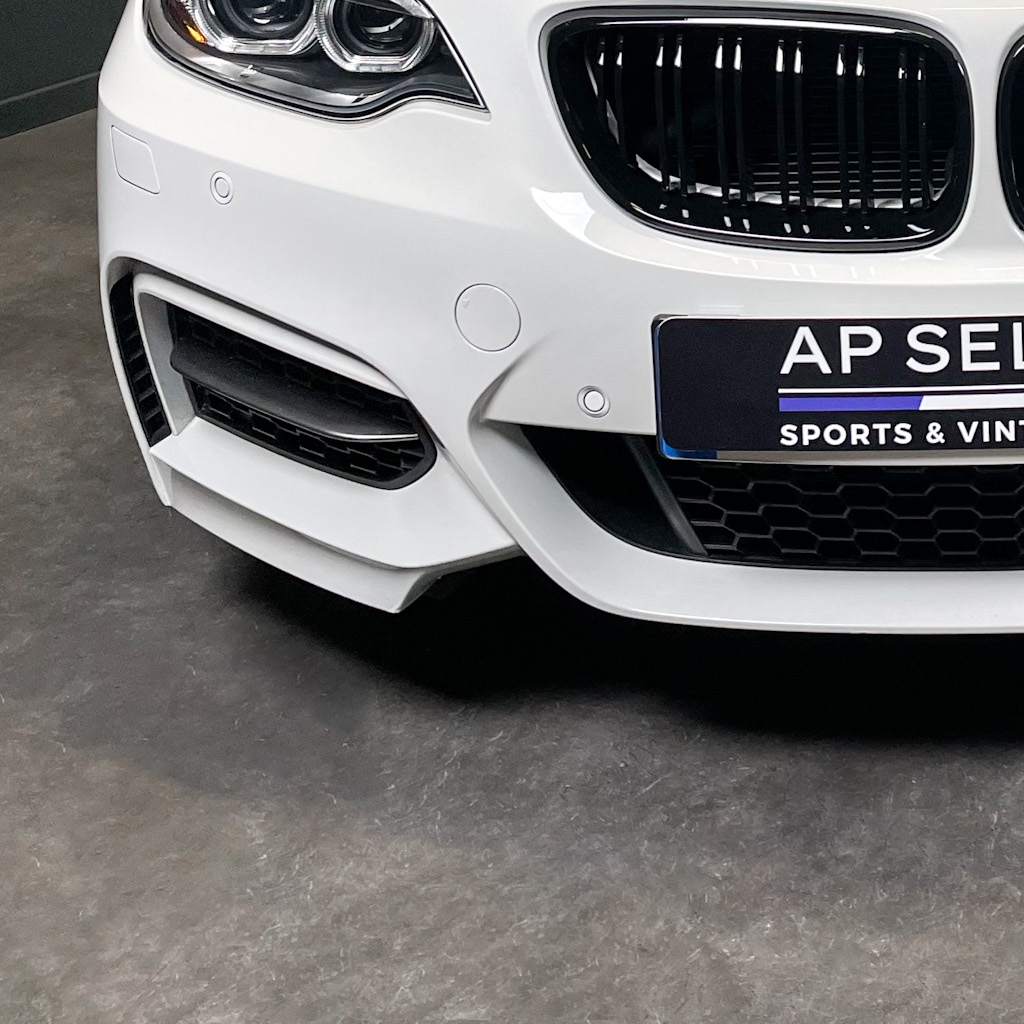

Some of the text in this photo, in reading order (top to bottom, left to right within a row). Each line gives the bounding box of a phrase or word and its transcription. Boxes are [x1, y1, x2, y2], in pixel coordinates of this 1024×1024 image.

[779, 325, 883, 375] AP
[779, 422, 913, 446] SPORTS
[925, 421, 946, 444] &
